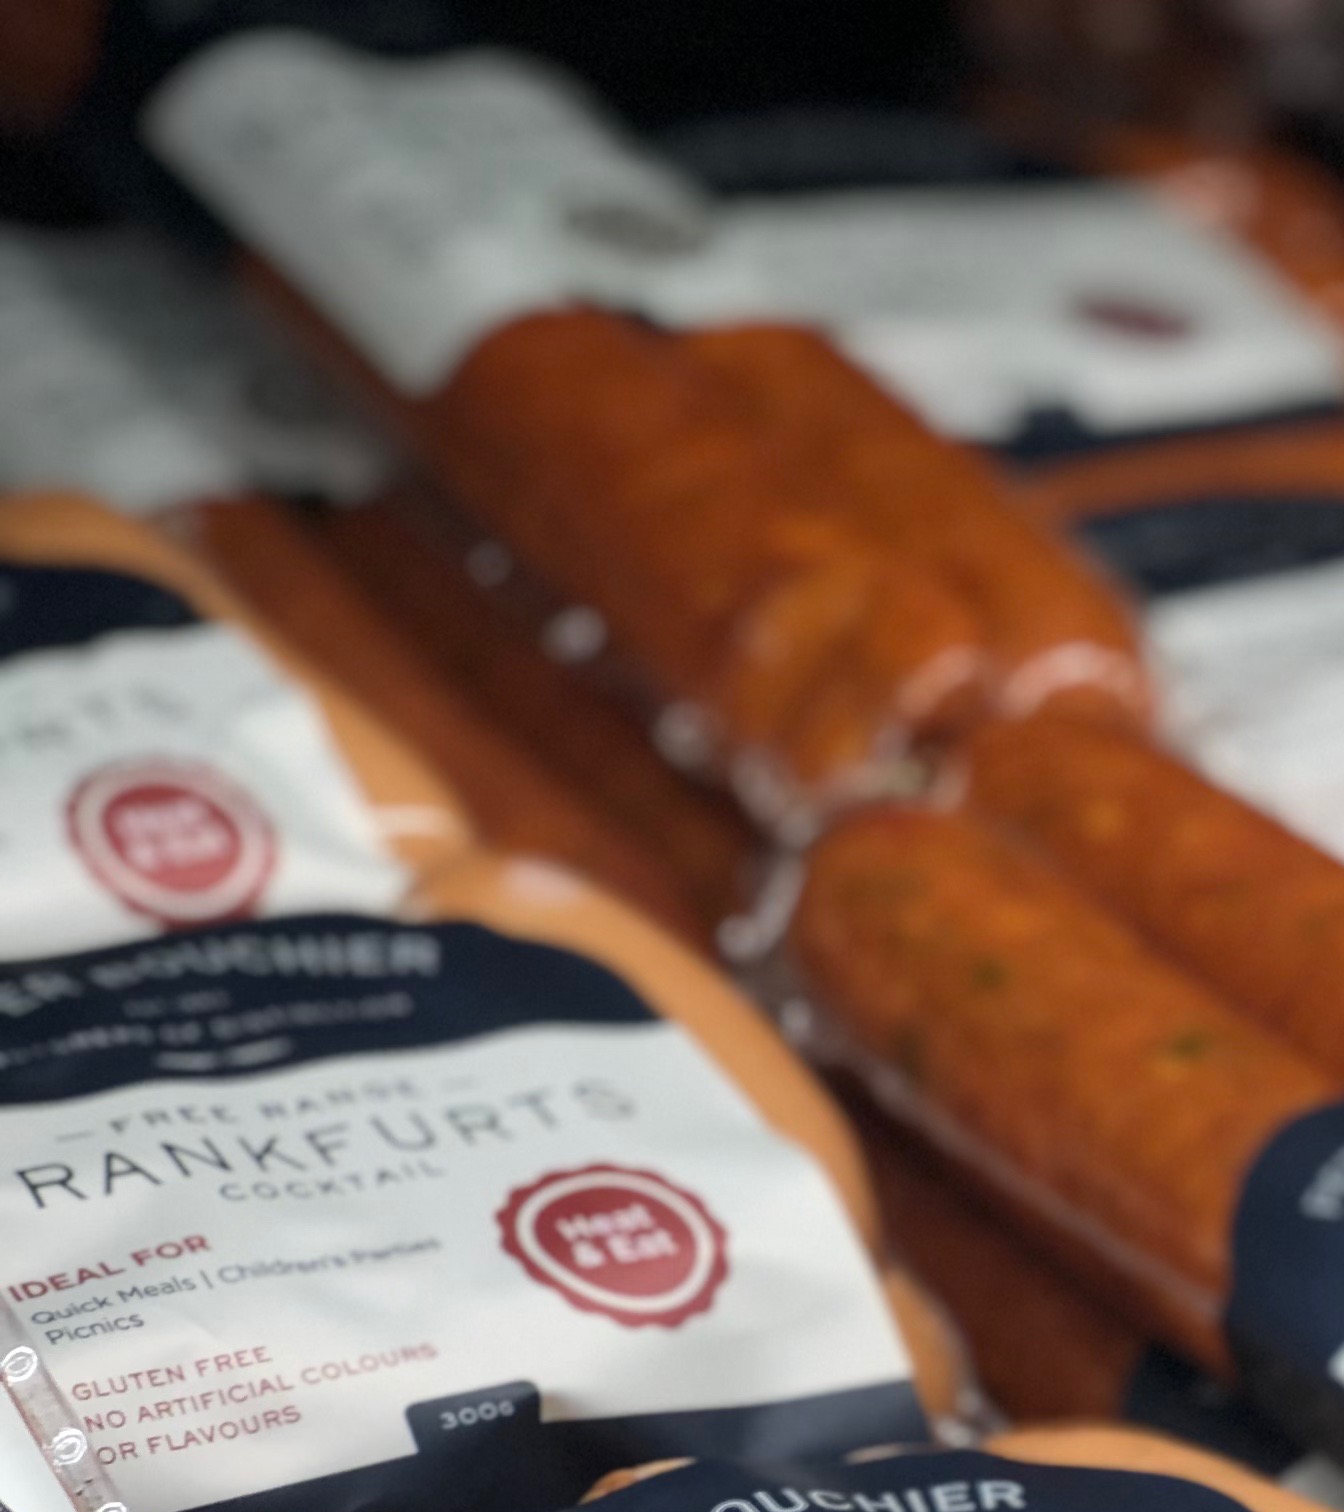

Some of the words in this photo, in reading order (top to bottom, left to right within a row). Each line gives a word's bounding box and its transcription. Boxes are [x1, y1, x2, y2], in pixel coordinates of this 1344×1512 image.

[15, 1079, 638, 1209] RANKFURTS
[109, 1104, 242, 1136] FREE
[218, 1160, 445, 1202] COCKTAIL
[555, 1202, 656, 1241] Heat
[607, 1229, 679, 1263] Eat
[7, 1259, 126, 1303] IDEAL
[131, 1235, 213, 1268] FOR
[30, 1294, 110, 1326] Quick
[117, 1275, 197, 1304] Meals
[44, 1312, 146, 1345] Picnics
[72, 1363, 187, 1401] GLUTEN
[195, 1346, 273, 1378] FREE
[84, 1409, 127, 1433] NO
[137, 1374, 295, 1425] ARTIFICIAL
[301, 1342, 439, 1386] COLOURS
[96, 1440, 140, 1466] OR
[148, 1404, 303, 1454] FLAVOURS
